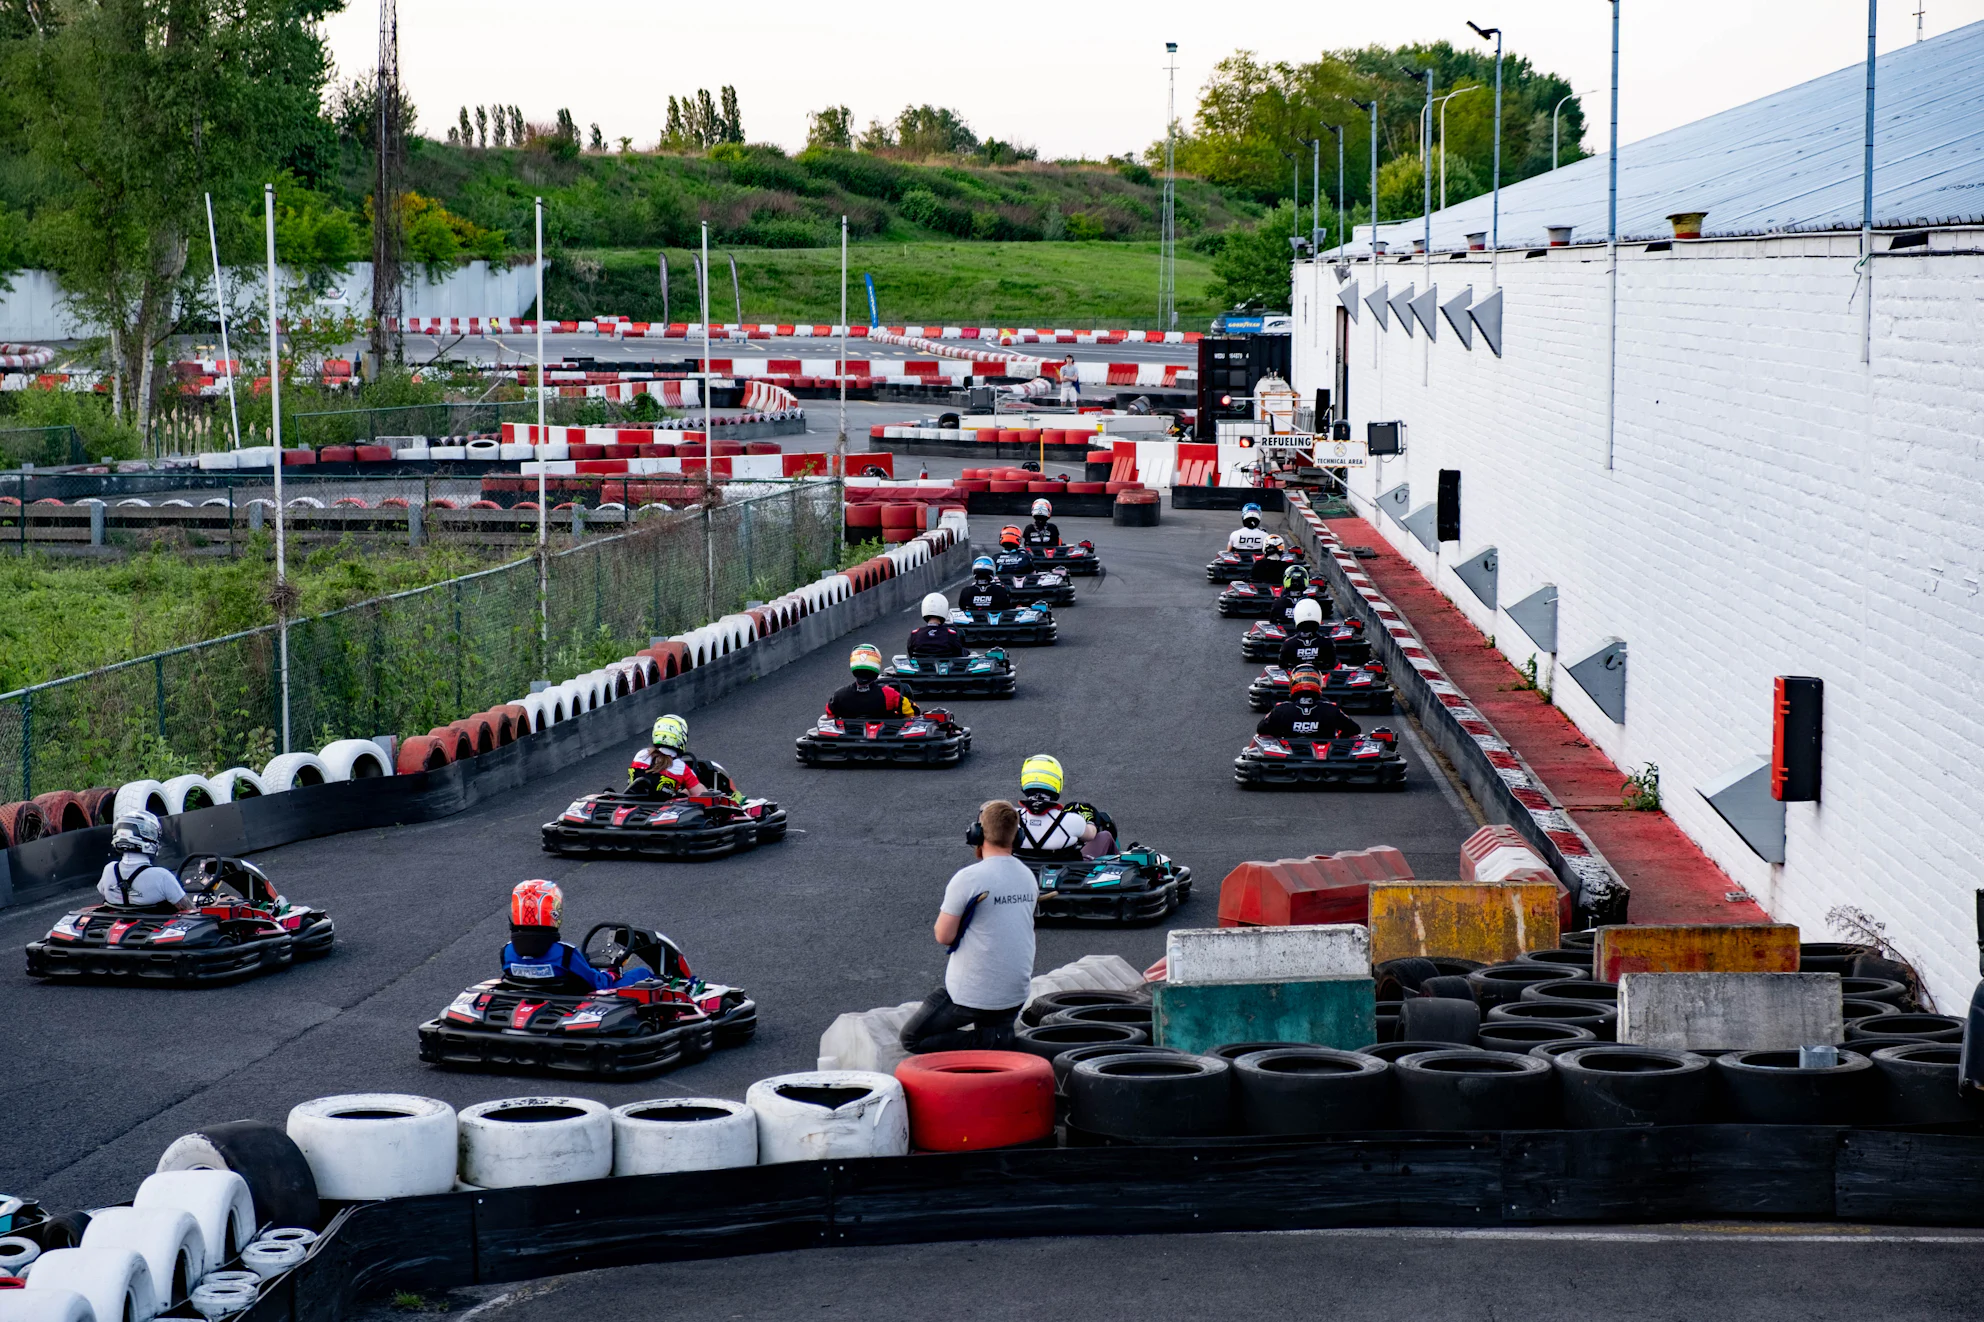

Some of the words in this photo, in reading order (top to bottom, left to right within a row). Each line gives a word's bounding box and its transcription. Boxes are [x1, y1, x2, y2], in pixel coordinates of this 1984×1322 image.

[1261, 437, 1311, 446] REFUELING
[1239, 535, 1261, 543] bnc
[973, 595, 992, 604] RCN
[1297, 647, 1319, 656] RCN
[1293, 721, 1319, 731] RCN
[993, 894, 1034, 905] MARSHALL
[582, 1004, 609, 1016] 40
